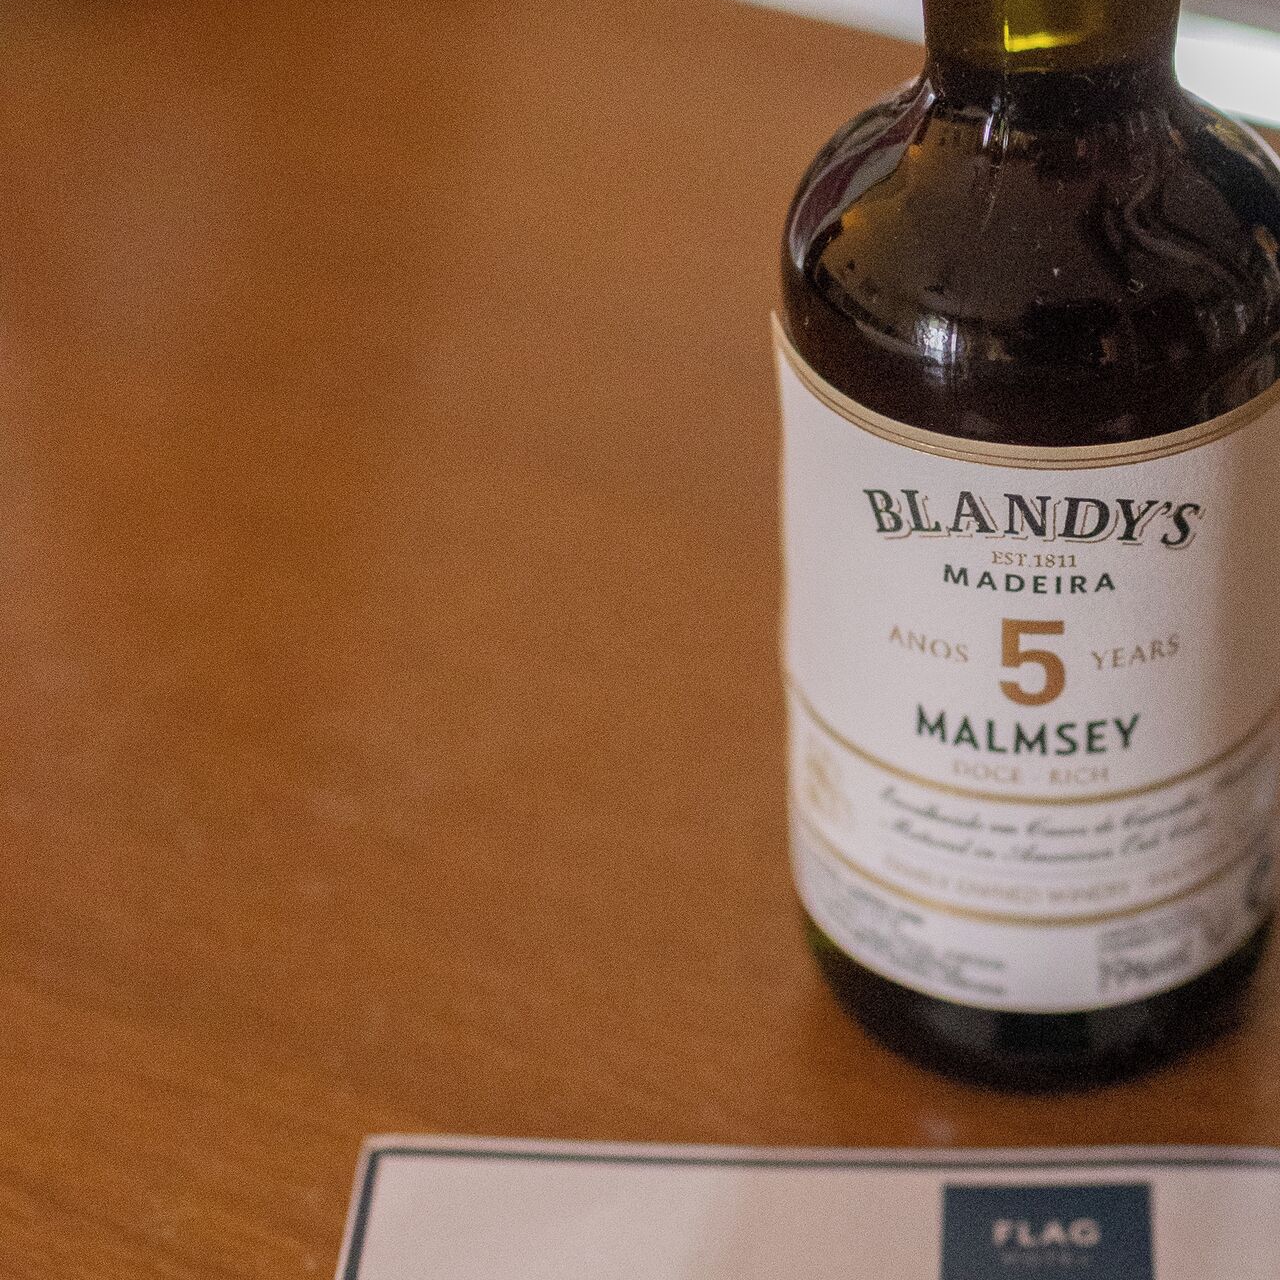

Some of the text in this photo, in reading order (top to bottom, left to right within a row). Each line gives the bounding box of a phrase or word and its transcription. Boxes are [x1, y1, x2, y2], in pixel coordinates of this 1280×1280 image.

[863, 489, 1205, 550] BLANDY'S
[943, 564, 1116, 594] MADEIRA
[888, 617, 1181, 707] ANOS 5 YEARS
[915, 704, 1140, 756] MALMSEY
[992, 1218, 1101, 1246] FLAG
